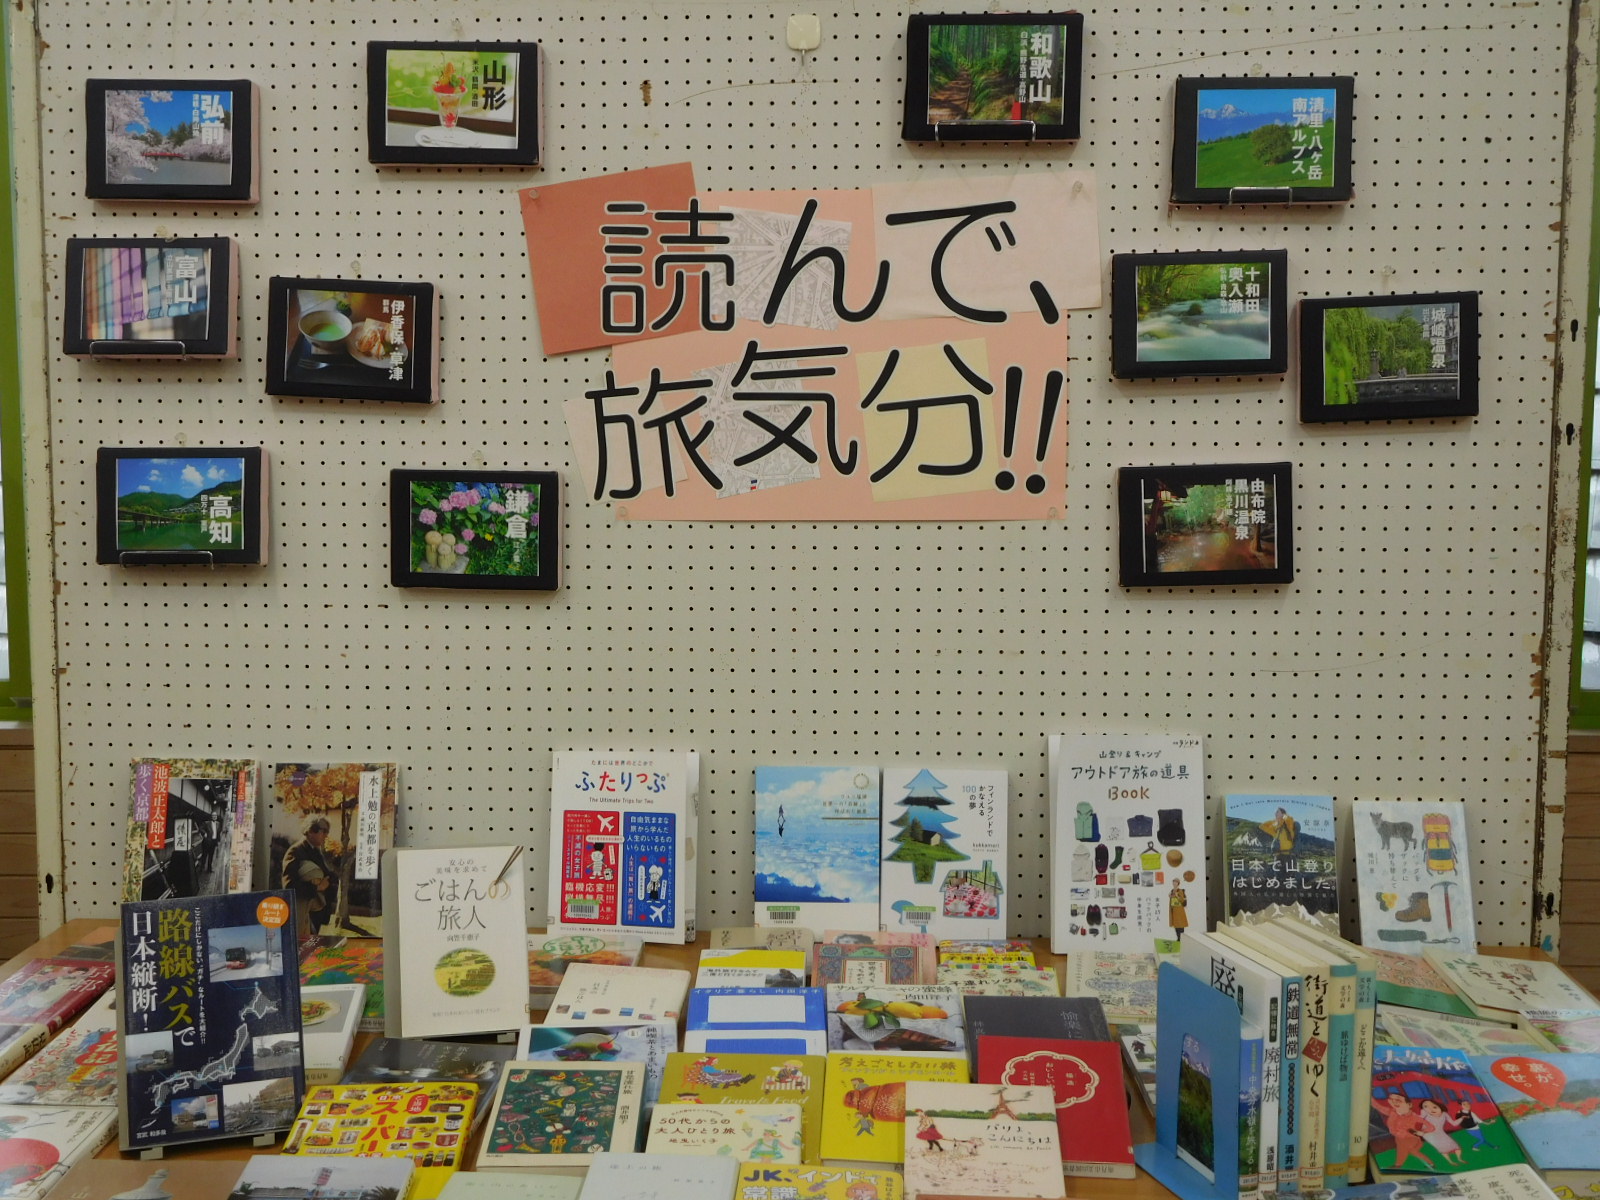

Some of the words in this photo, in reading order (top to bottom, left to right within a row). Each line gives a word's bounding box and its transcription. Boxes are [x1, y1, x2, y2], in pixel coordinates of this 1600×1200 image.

[482, 60, 507, 110] 山形
[1029, 32, 1053, 103] 和歌山
[200, 94, 225, 145] 弘前
[1291, 98, 1309, 175] 南アルプス
[174, 255, 199, 304] 富山
[600, 197, 1061, 334] 読んで、
[1245, 267, 1261, 313] 十和田
[1228, 267, 1244, 314] 奥入瀬
[389, 299, 406, 382] 伊香保・草津
[1431, 307, 1447, 370] 城崎温泉
[208, 494, 233, 544] 高知
[505, 489, 530, 539] 鎌倉
[1234, 479, 1249, 541] 黒川温泉
[1250, 478, 1266, 525] 由布院
[135, 765, 152, 821] 歩く京都
[575, 771, 666, 794] ふたりっぷ
[1071, 763, 1190, 780] アウトドア旅の道具
[150, 765, 169, 848] 池波正太郎と
[630, 816, 669, 824] 自由気ままな
[978, 785, 986, 816] かなえる
[986, 785, 995, 837] フィンランドで
[366, 775, 380, 876] 水上勉の京都を歩く
[626, 834, 672, 844] 人生のいるもの
[626, 844, 666, 853] いらないもの
[630, 825, 669, 834] 旅から学んだ
[1231, 858, 1335, 873] 日本で山登り
[1232, 876, 1337, 891] はじめました。
[414, 878, 512, 903] ごはんの
[437, 904, 487, 931] 旅人
[159, 908, 196, 1047] 路線バスで
[1285, 987, 1300, 1055] 鉄道無常
[1262, 1046, 1281, 1102] 廃村旅
[354, 1102, 399, 1152] スーパー
[654, 1127, 736, 1135] 大人ひとり旅
[658, 1117, 732, 1125] 50代からの
[987, 1133, 1053, 1146] こんにちは
